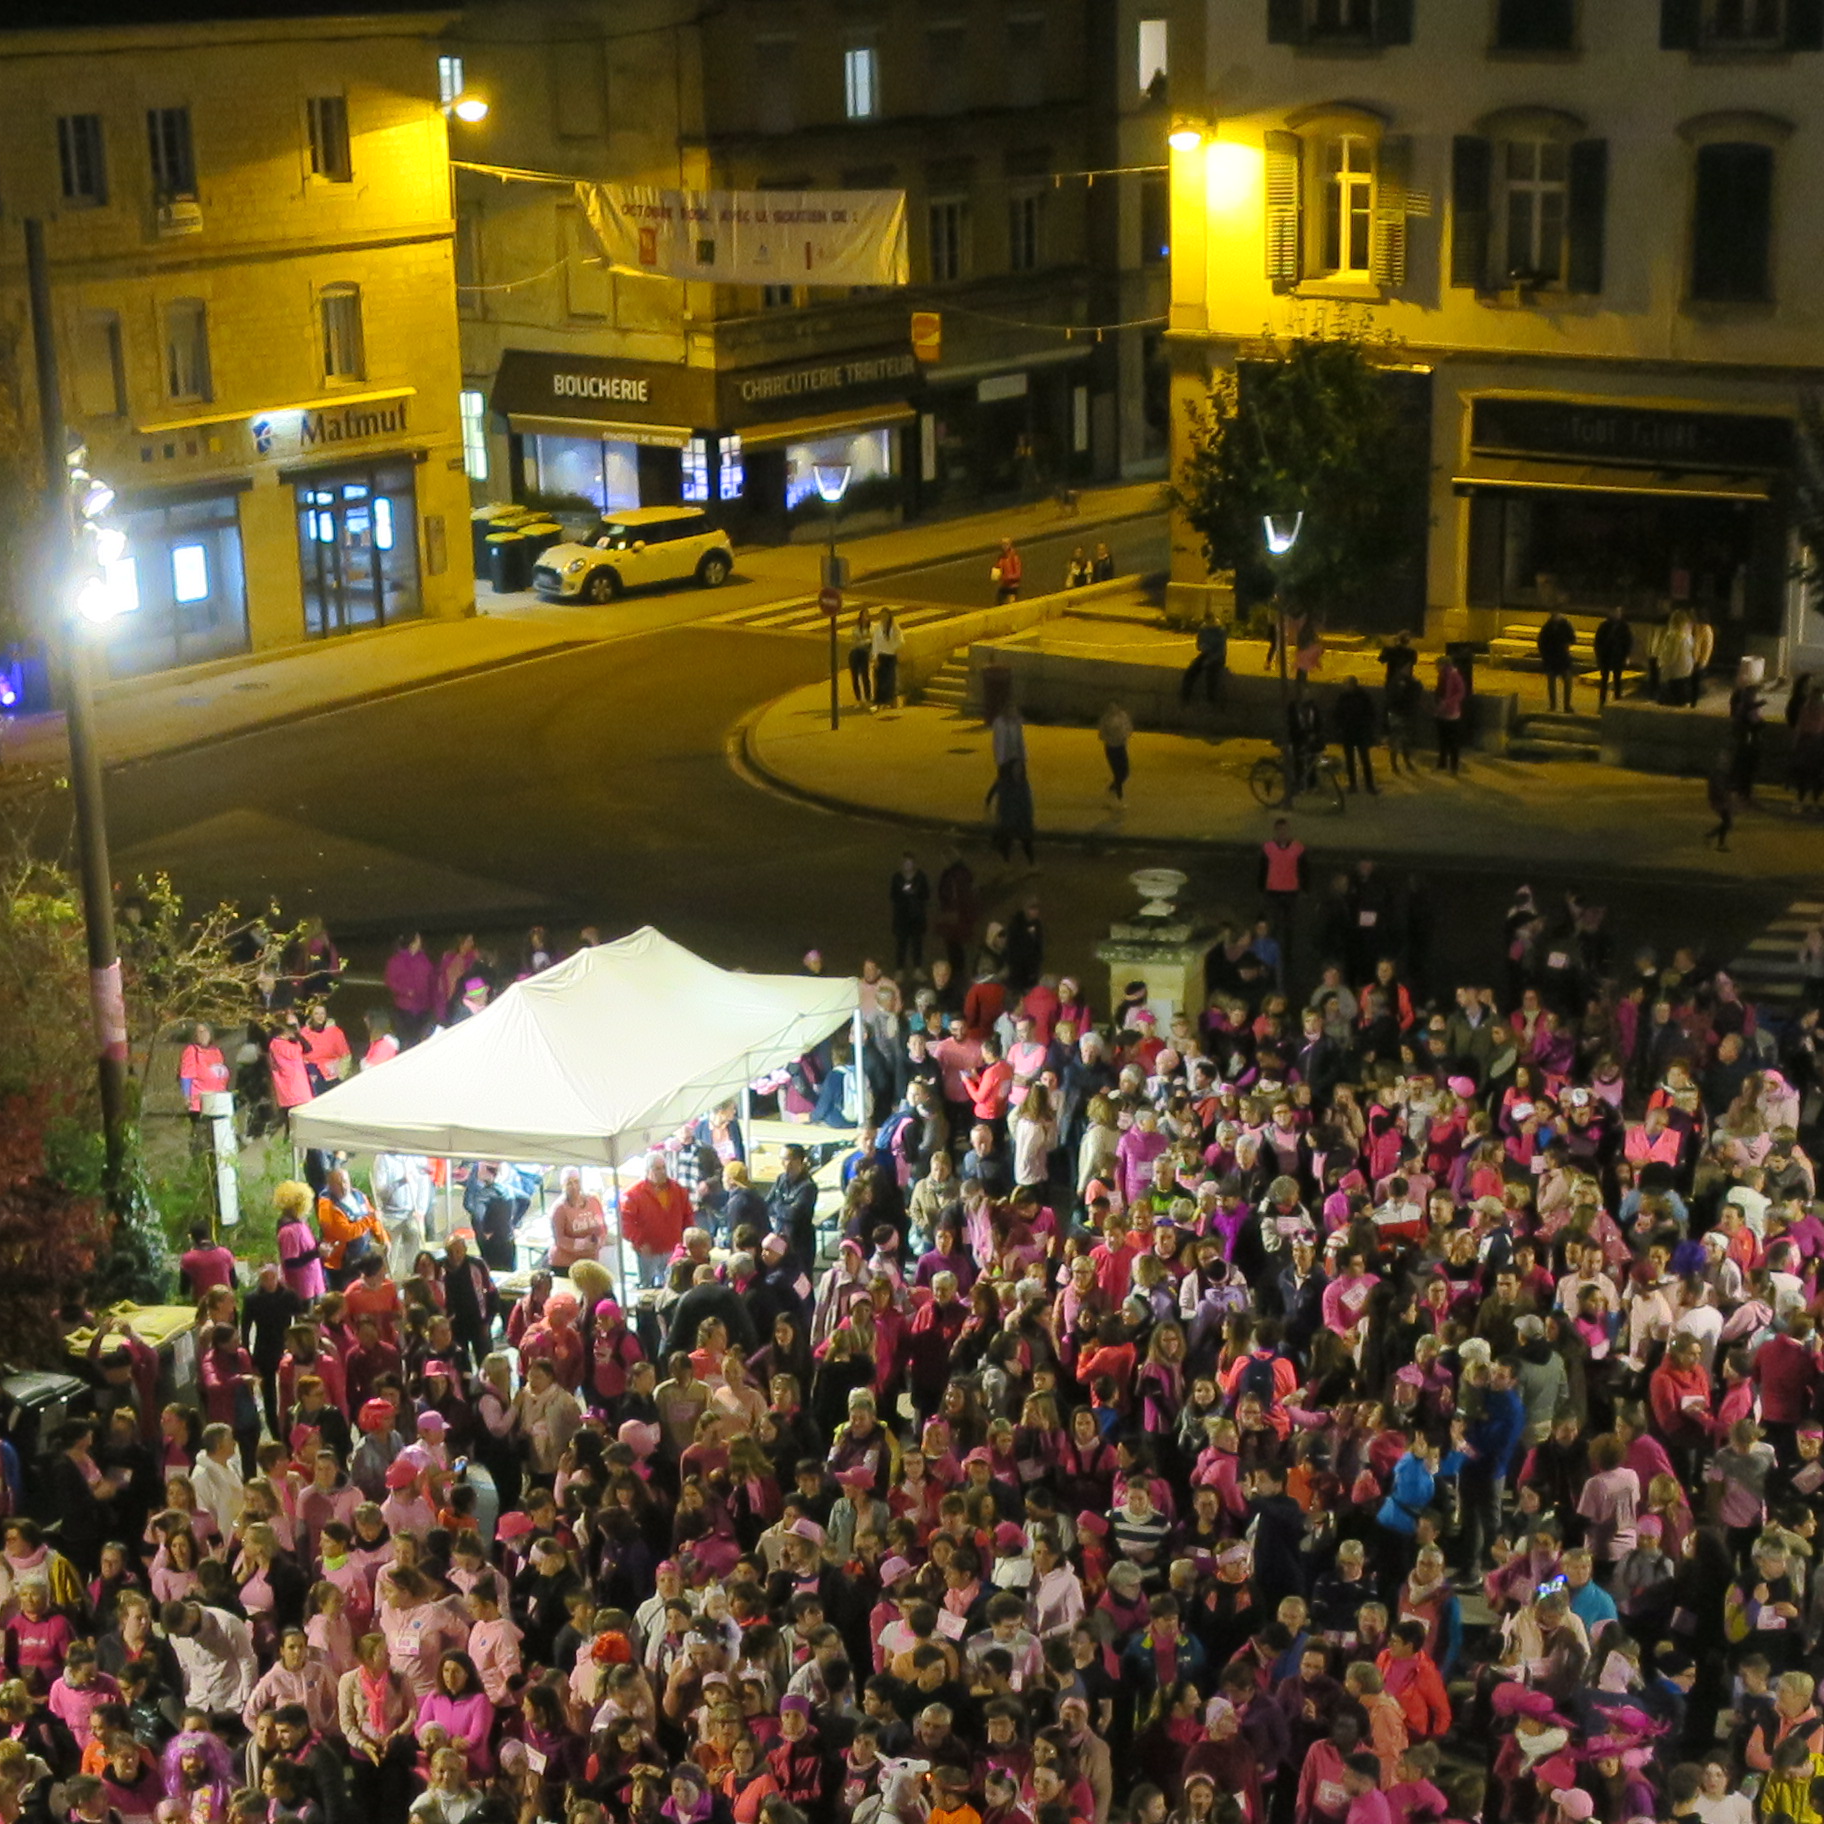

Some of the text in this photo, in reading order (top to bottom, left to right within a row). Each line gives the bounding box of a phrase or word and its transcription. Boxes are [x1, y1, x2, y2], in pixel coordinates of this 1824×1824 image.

[553, 374, 649, 402] BOUCHERIE
[742, 354, 916, 401] CHARCUTERIE TRAITEUR
[300, 401, 407, 446] Matmut
